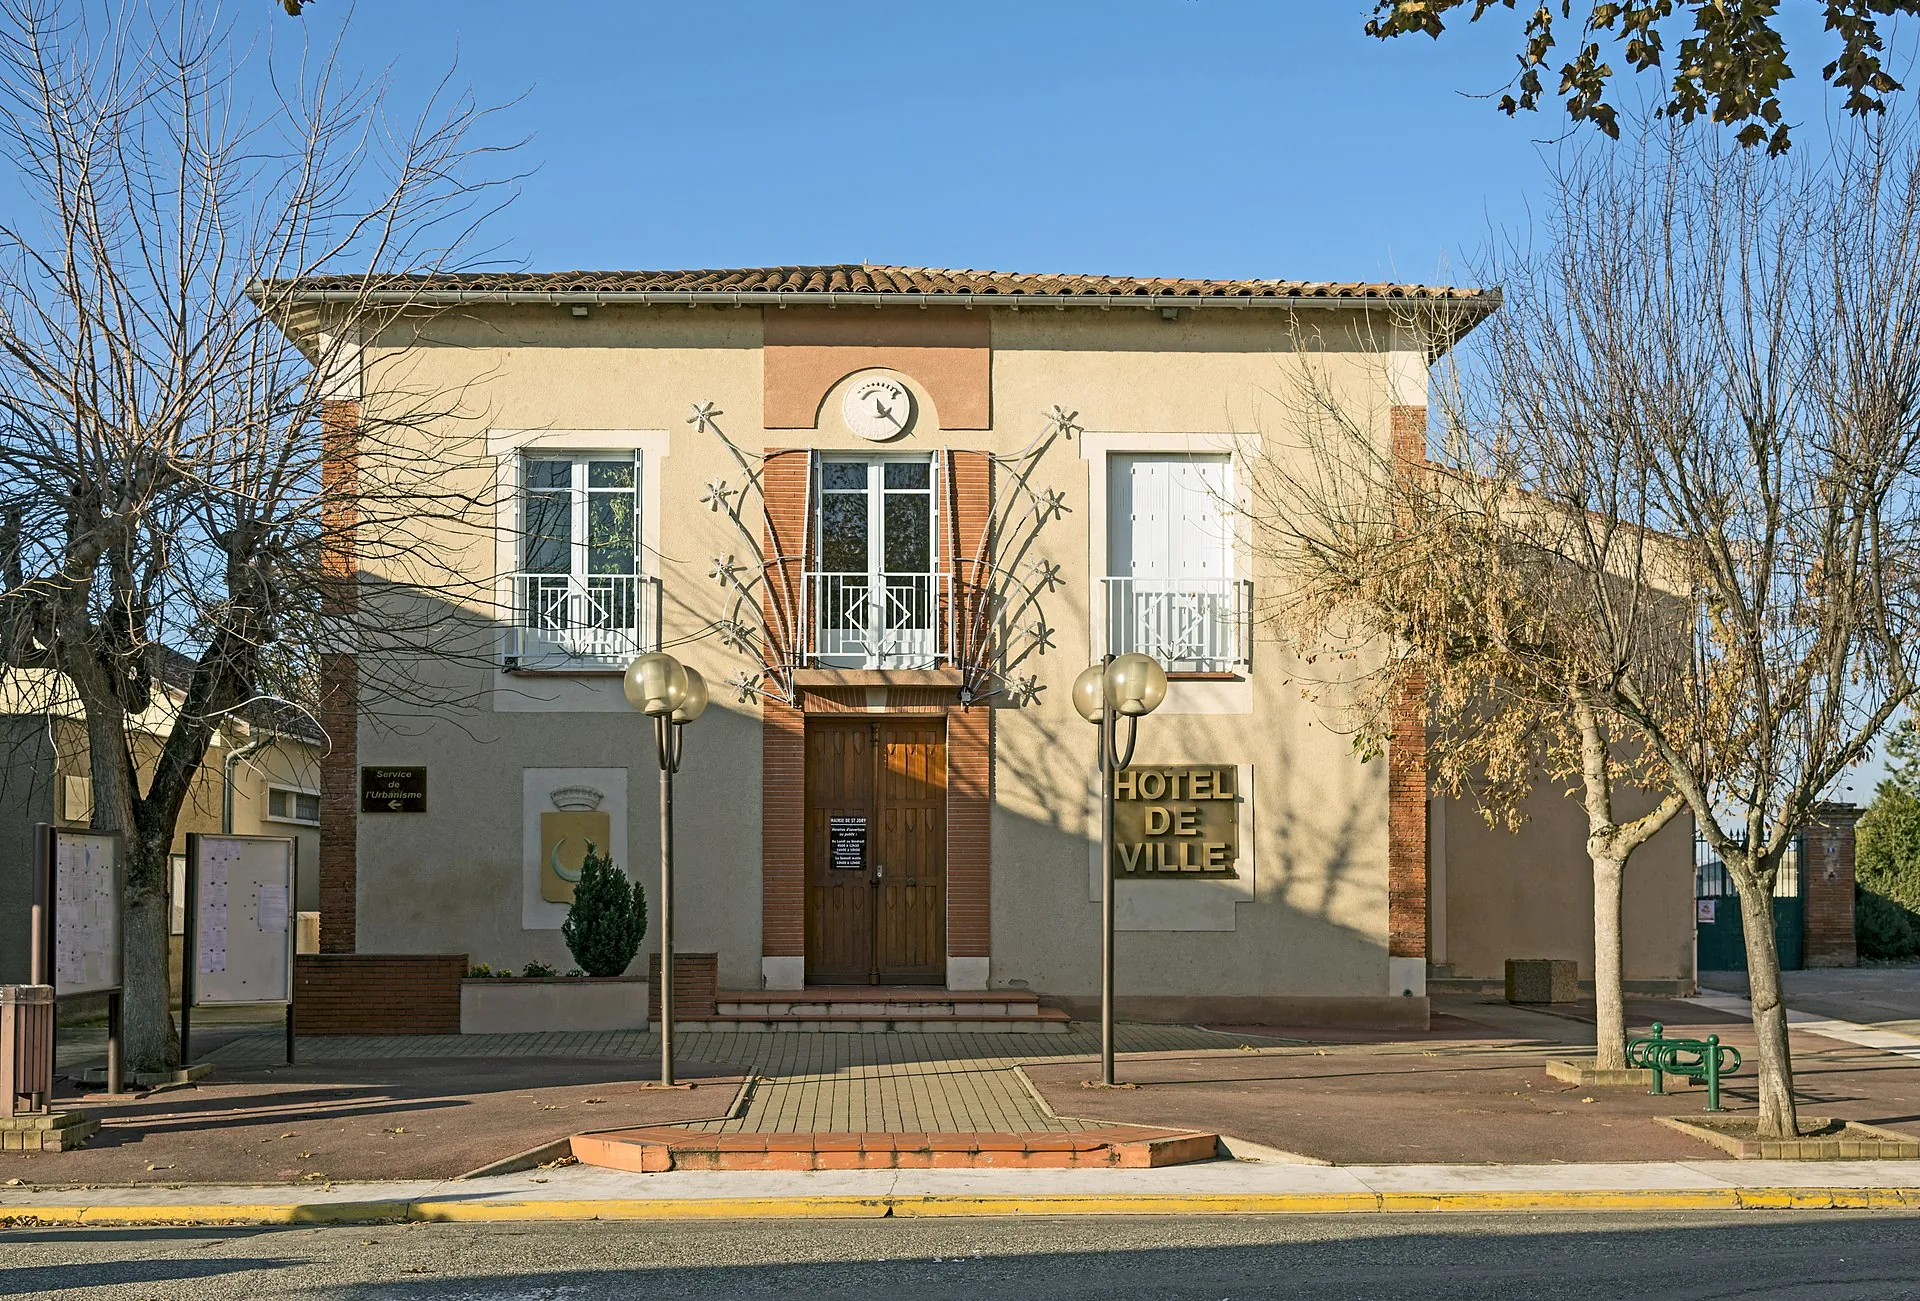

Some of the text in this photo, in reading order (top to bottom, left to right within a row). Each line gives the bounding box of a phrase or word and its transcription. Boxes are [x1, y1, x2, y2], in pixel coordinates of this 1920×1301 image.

[1114, 771, 1233, 799] HOTEL
[1145, 807, 1197, 835] DE
[1117, 843, 1226, 871] VILLE
